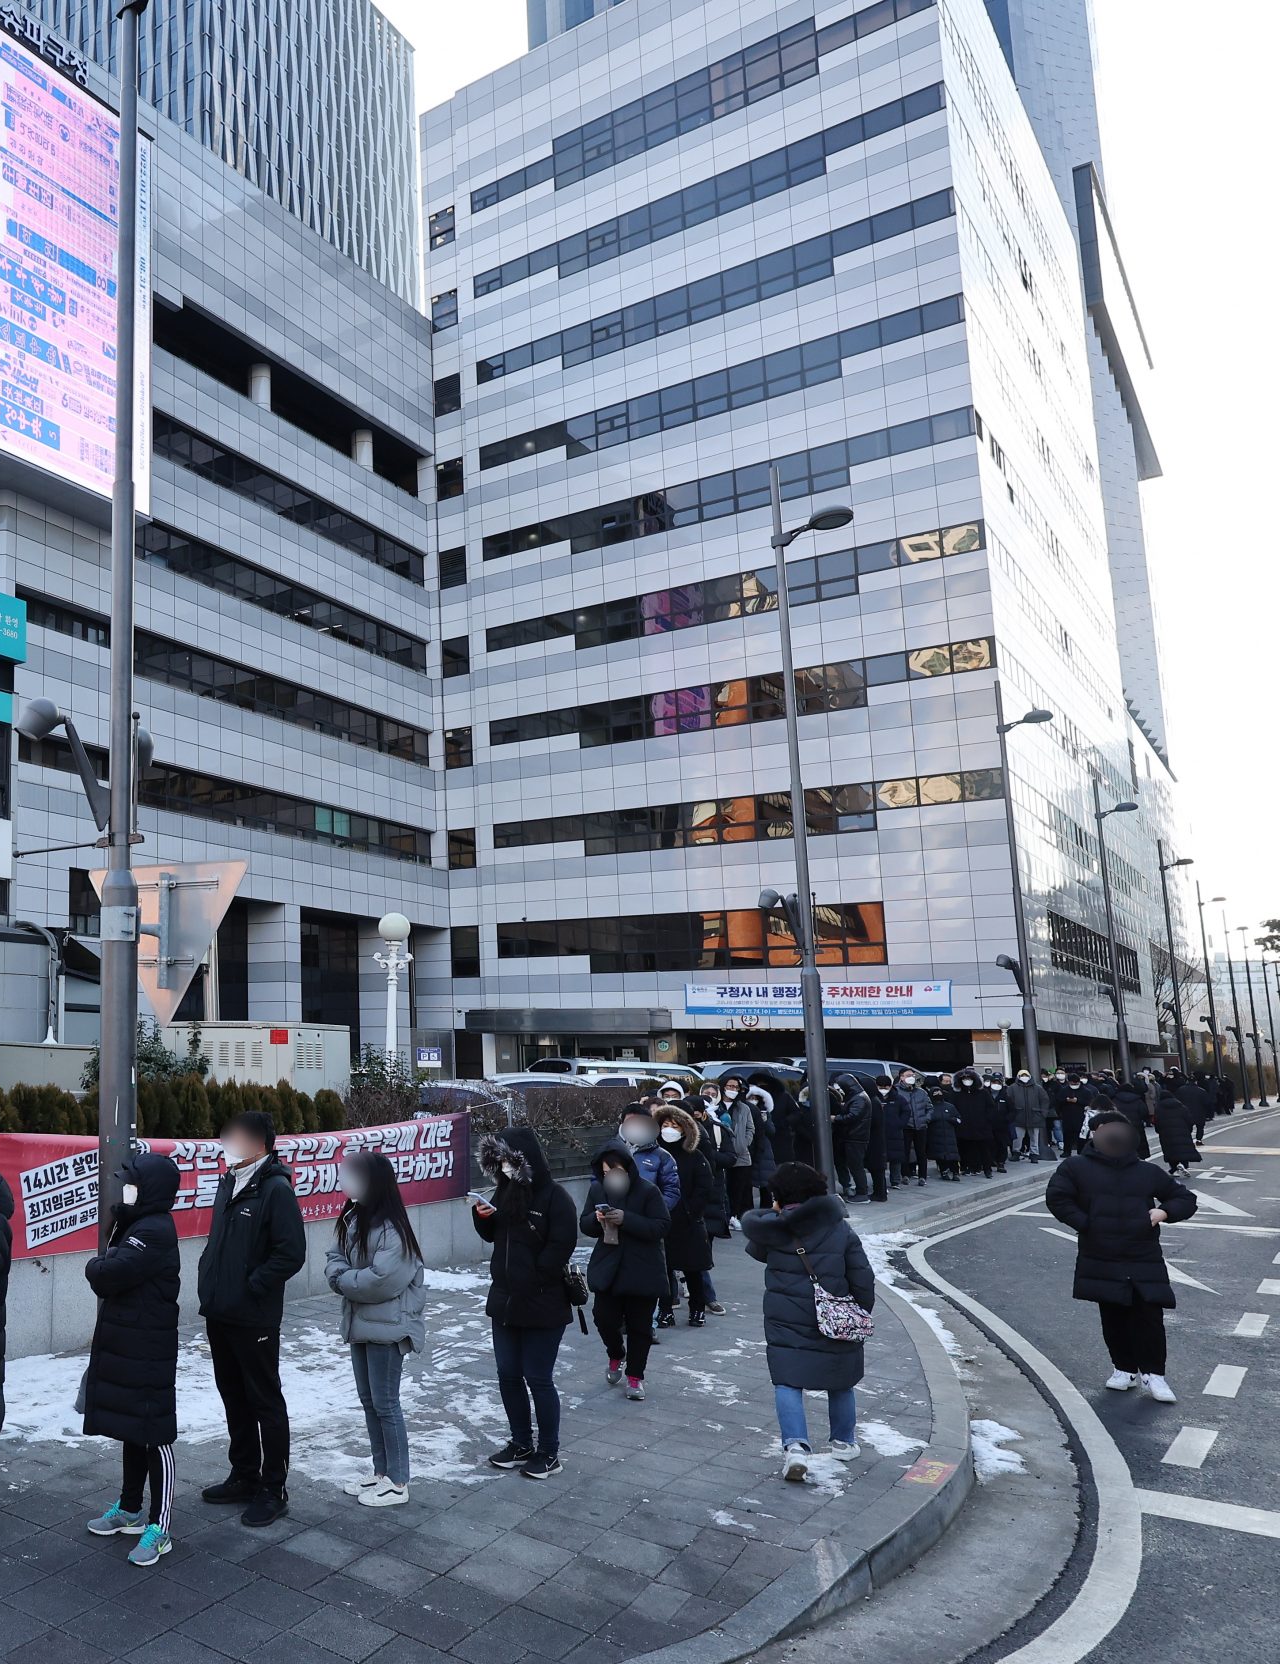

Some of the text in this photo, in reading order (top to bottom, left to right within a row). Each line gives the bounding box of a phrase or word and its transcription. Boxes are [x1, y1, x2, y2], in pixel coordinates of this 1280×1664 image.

[0, 3, 90, 87] 송파구청
[716, 986, 752, 998] 구청사
[756, 986, 769, 998] 내
[827, 985, 881, 998] 주차제한
[885, 985, 913, 998] 안내
[170, 1118, 454, 1172] 선관 국민과 공무원에 대한
[23, 1163, 70, 1194] 14시간
[294, 1164, 345, 1197] 강제
[27, 1188, 87, 1221] 최저임금도
[30, 1215, 78, 1243] 기초지자체
